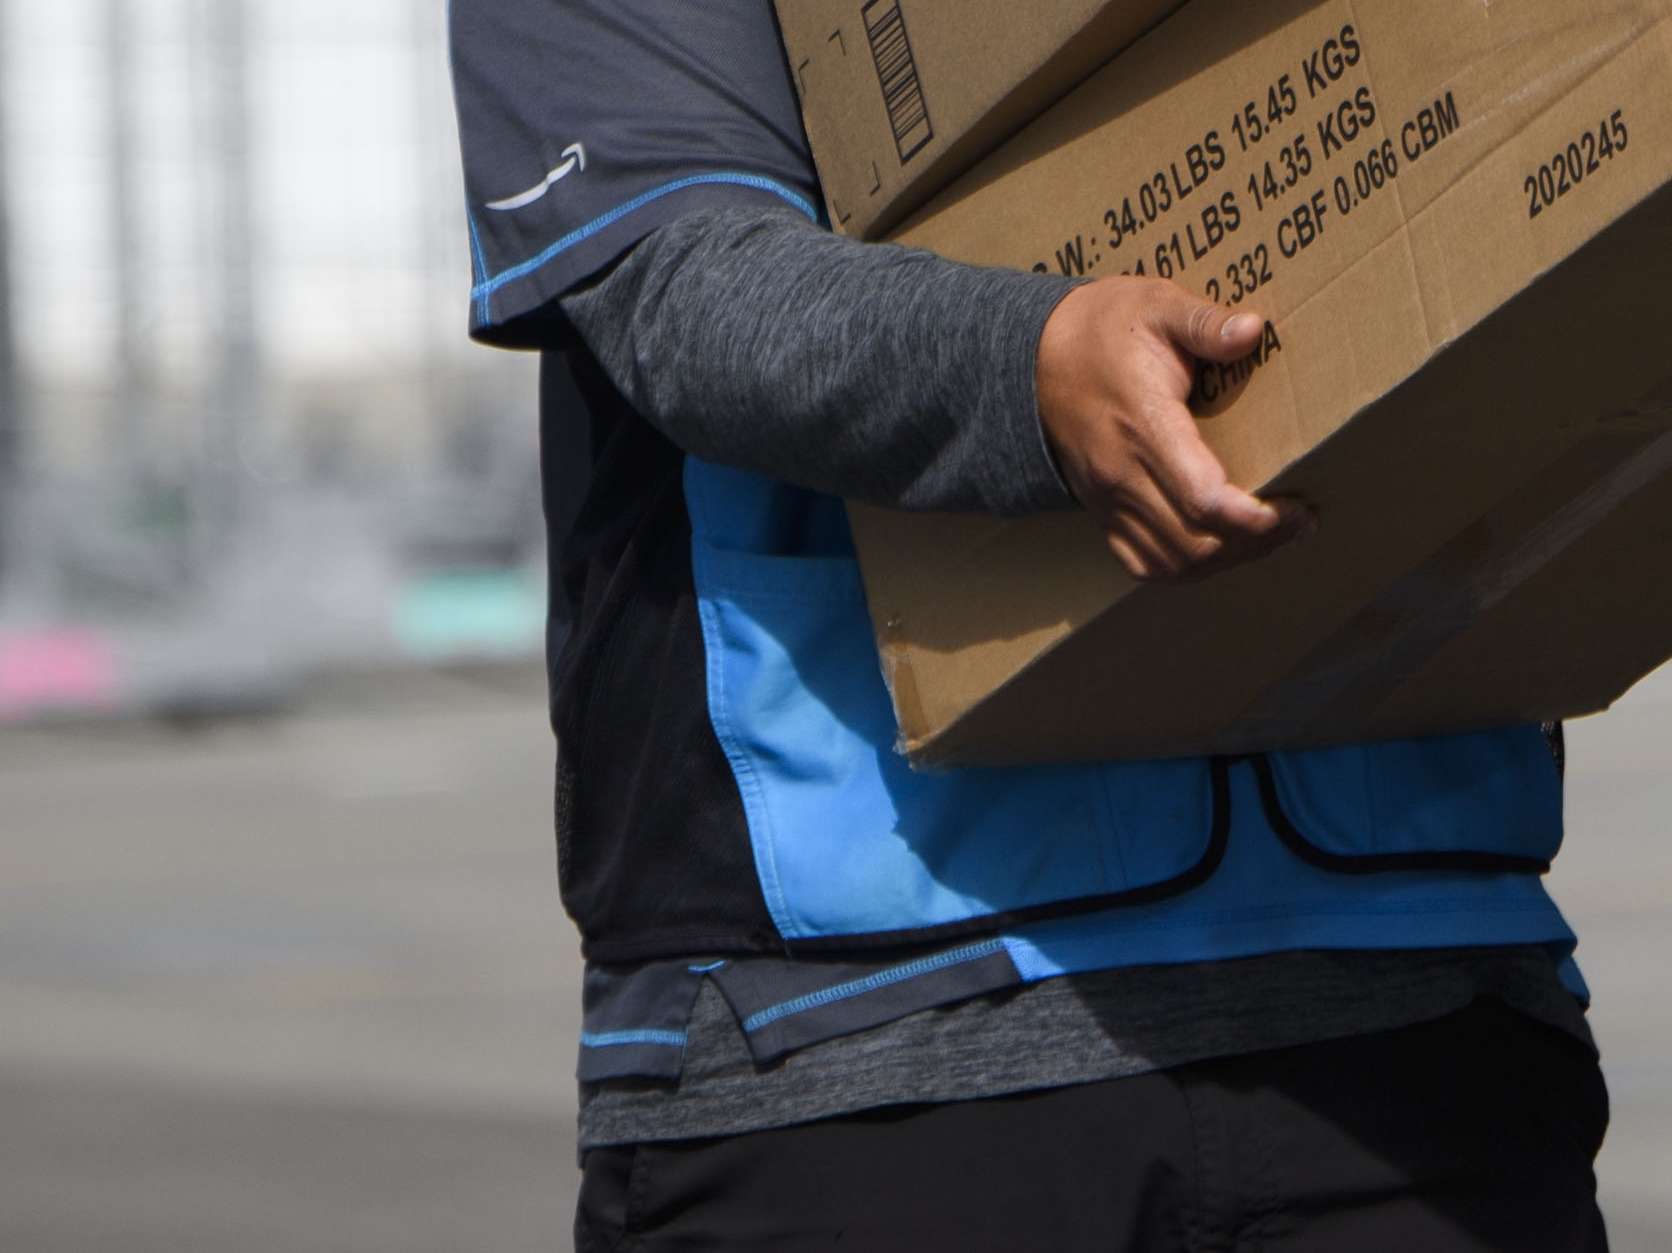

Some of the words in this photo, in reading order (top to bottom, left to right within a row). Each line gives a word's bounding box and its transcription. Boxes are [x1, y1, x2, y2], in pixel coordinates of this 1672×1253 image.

[1103, 172, 1172, 250] 34.03
[1169, 130, 1226, 200] LBS
[1231, 73, 1297, 152] 15.45
[1301, 24, 1361, 99] KGS
[1185, 191, 1242, 261] LBS
[1247, 133, 1312, 212] 14.35
[1316, 86, 1376, 160] KGS
[1277, 188, 1327, 259] CBF
[1333, 138, 1398, 216] 0.066
[1401, 91, 1460, 163] CBM
[1523, 109, 1629, 220] 2020245
